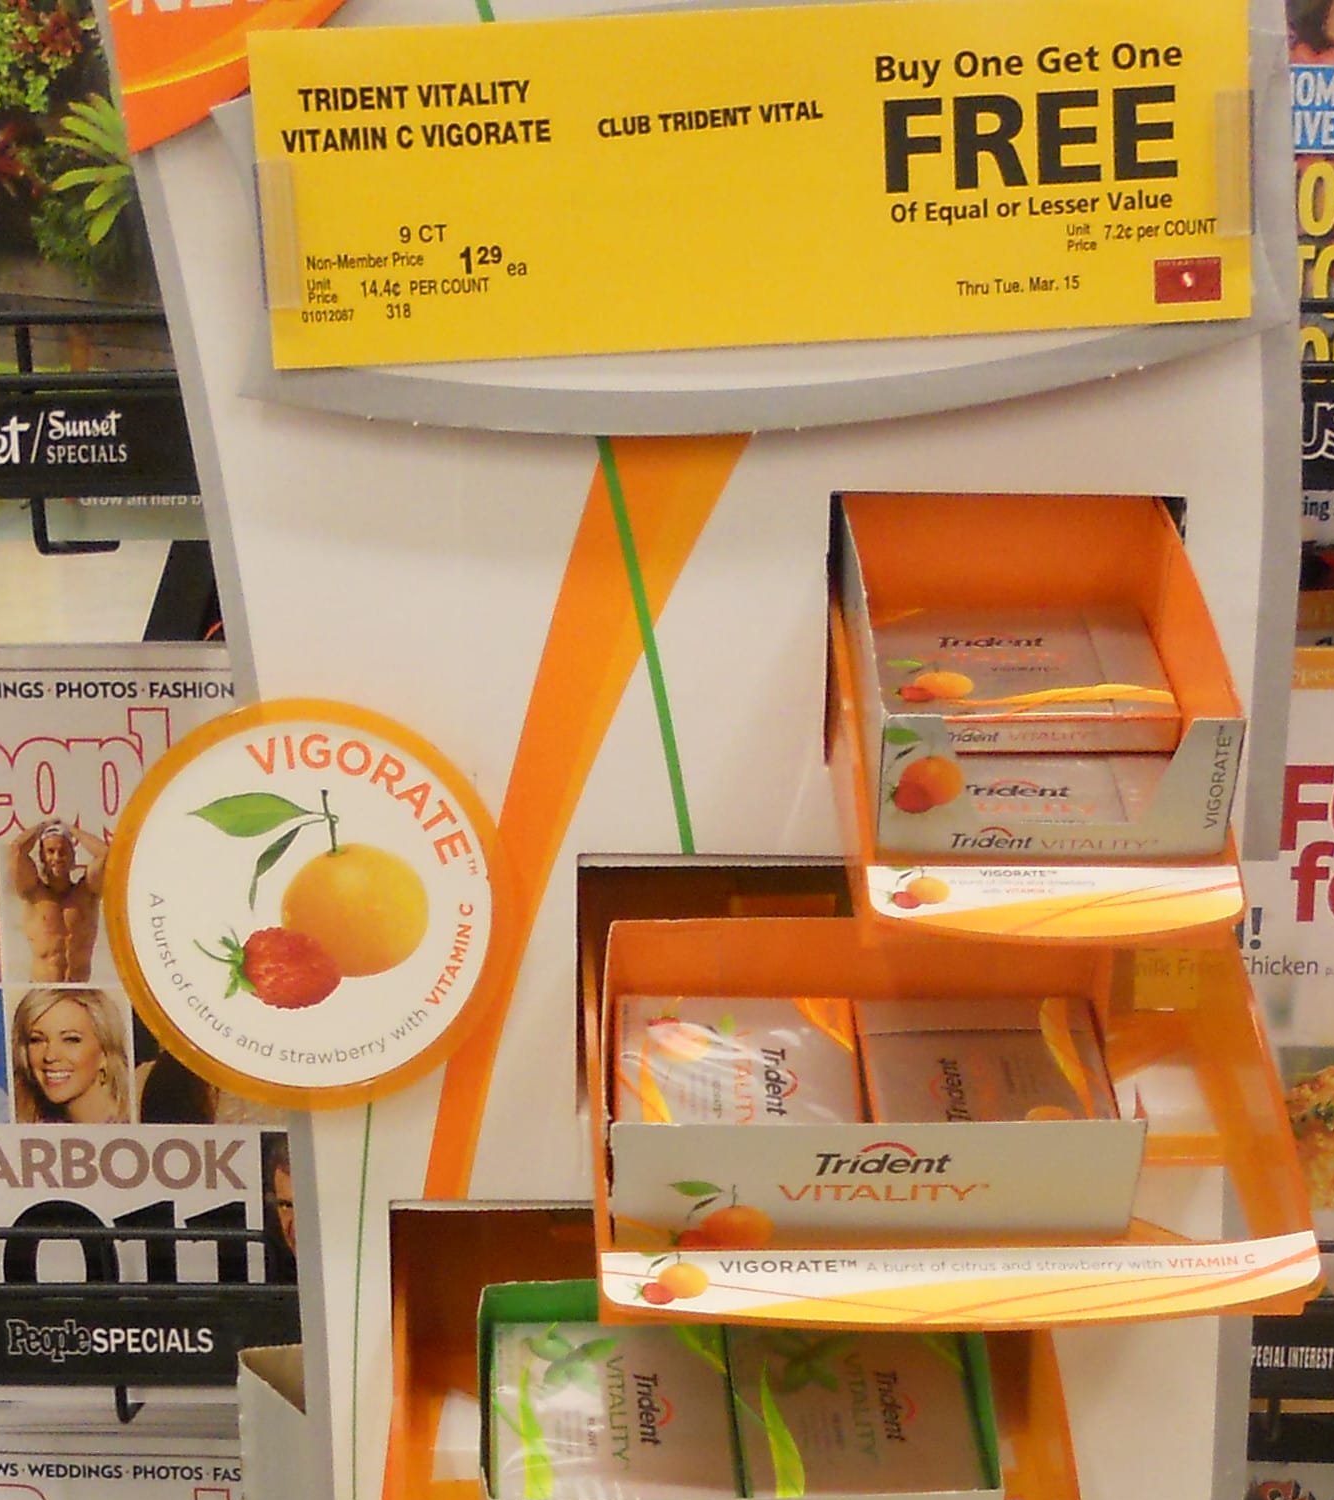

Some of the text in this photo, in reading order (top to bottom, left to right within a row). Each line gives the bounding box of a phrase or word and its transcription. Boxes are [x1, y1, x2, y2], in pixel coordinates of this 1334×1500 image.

[874, 42, 1183, 89] Buy One Get One
[298, 80, 530, 112] TRIDENT VITALITY
[598, 100, 824, 139] CLUB TRIDENT VITAL
[282, 119, 551, 153] VITAMIN C VIGORATE
[883, 85, 1179, 194] FREE
[890, 189, 1172, 226] Of Equal or Lesser Value
[399, 224, 447, 244] 9 CT
[1066, 218, 1217, 241] Unit 7.2¢ per COUNT
[1066, 238, 1097, 252] Price
[306, 251, 424, 271] Non-Member Price
[307, 277, 490, 298] Unit 14.4¢ PER COUNT
[956, 276, 1080, 296] Thru Tue. Mar. 15
[308, 291, 338, 304] Price
[386, 303, 411, 319] 318
[47, 410, 121, 441] Sunset
[46, 444, 127, 464] SPECIALS
[55, 681, 138, 699] PHOTOS
[149, 681, 235, 699] FASHION
[816, 1144, 952, 1177] Trident
[777, 1182, 987, 1204] VITALITY
[7, 1319, 214, 1361] People SPECIALS
